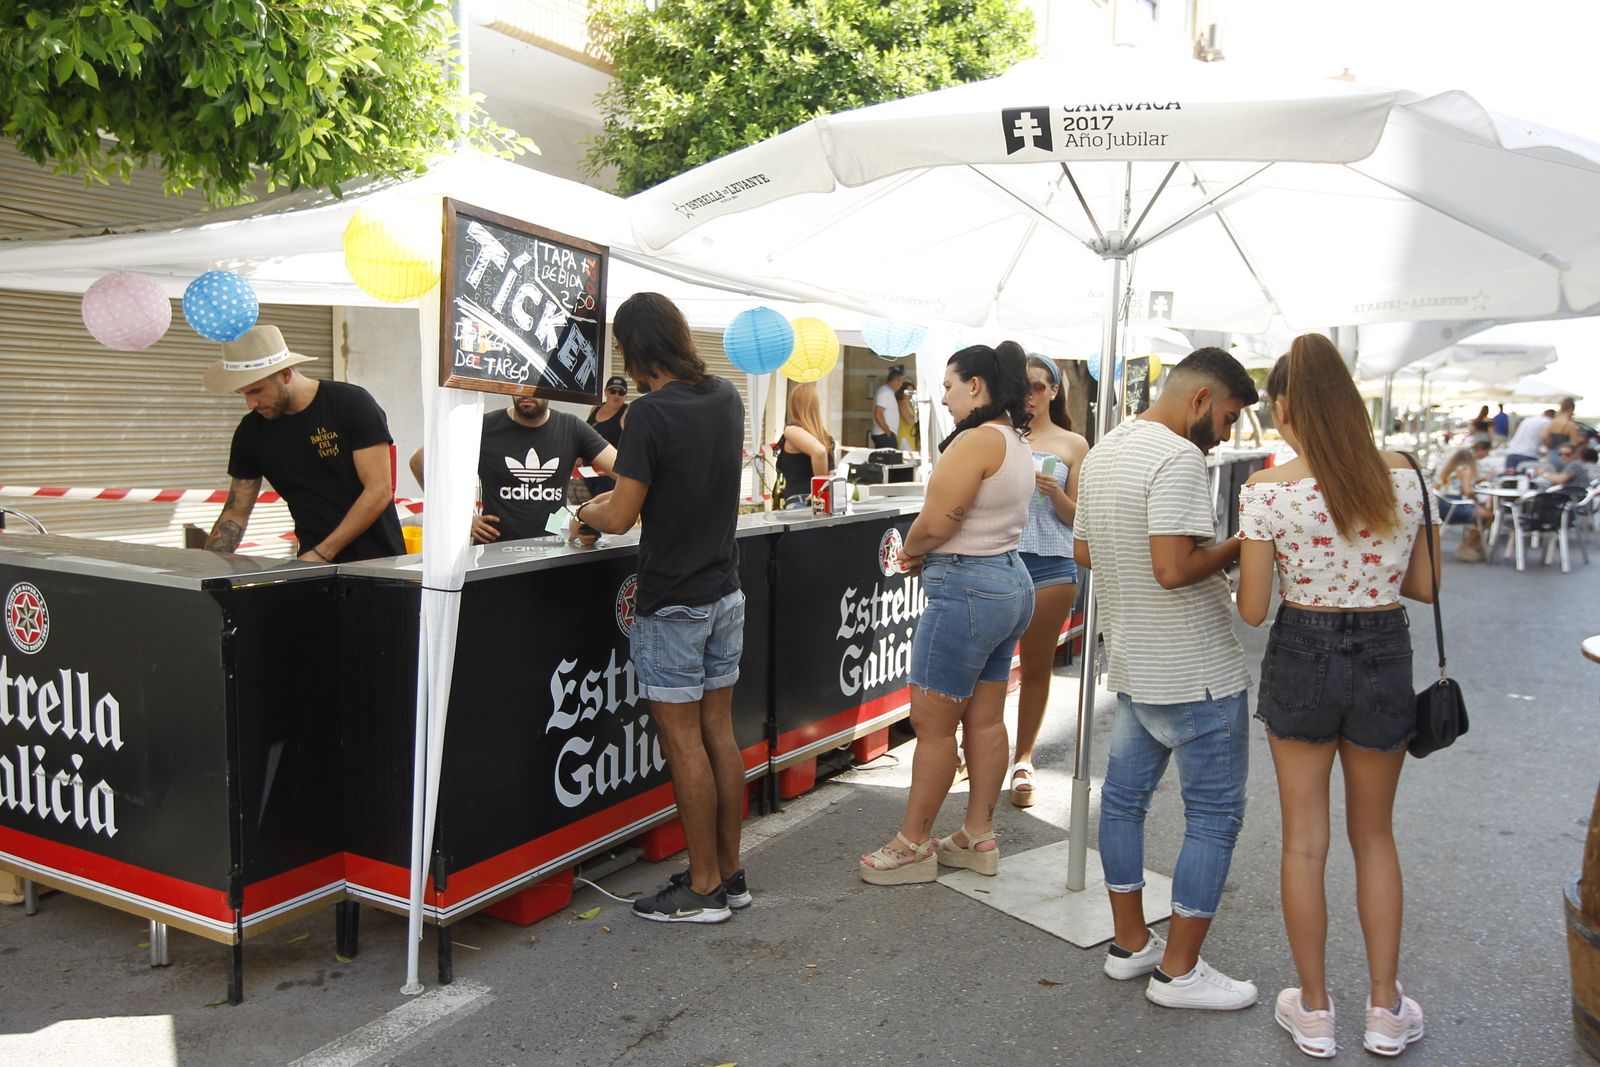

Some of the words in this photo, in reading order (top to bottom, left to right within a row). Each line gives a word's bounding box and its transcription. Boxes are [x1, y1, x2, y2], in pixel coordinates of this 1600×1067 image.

[1063, 115, 1114, 131] 2017
[1065, 132, 1103, 147] Año
[1106, 131, 1168, 150] Jubilar
[685, 190, 725, 210] ESTRELLA
[725, 173, 770, 195] LEVANTE
[539, 242, 577, 271] TAPA
[542, 265, 583, 290] BEBIDA
[500, 484, 563, 501] adidas
